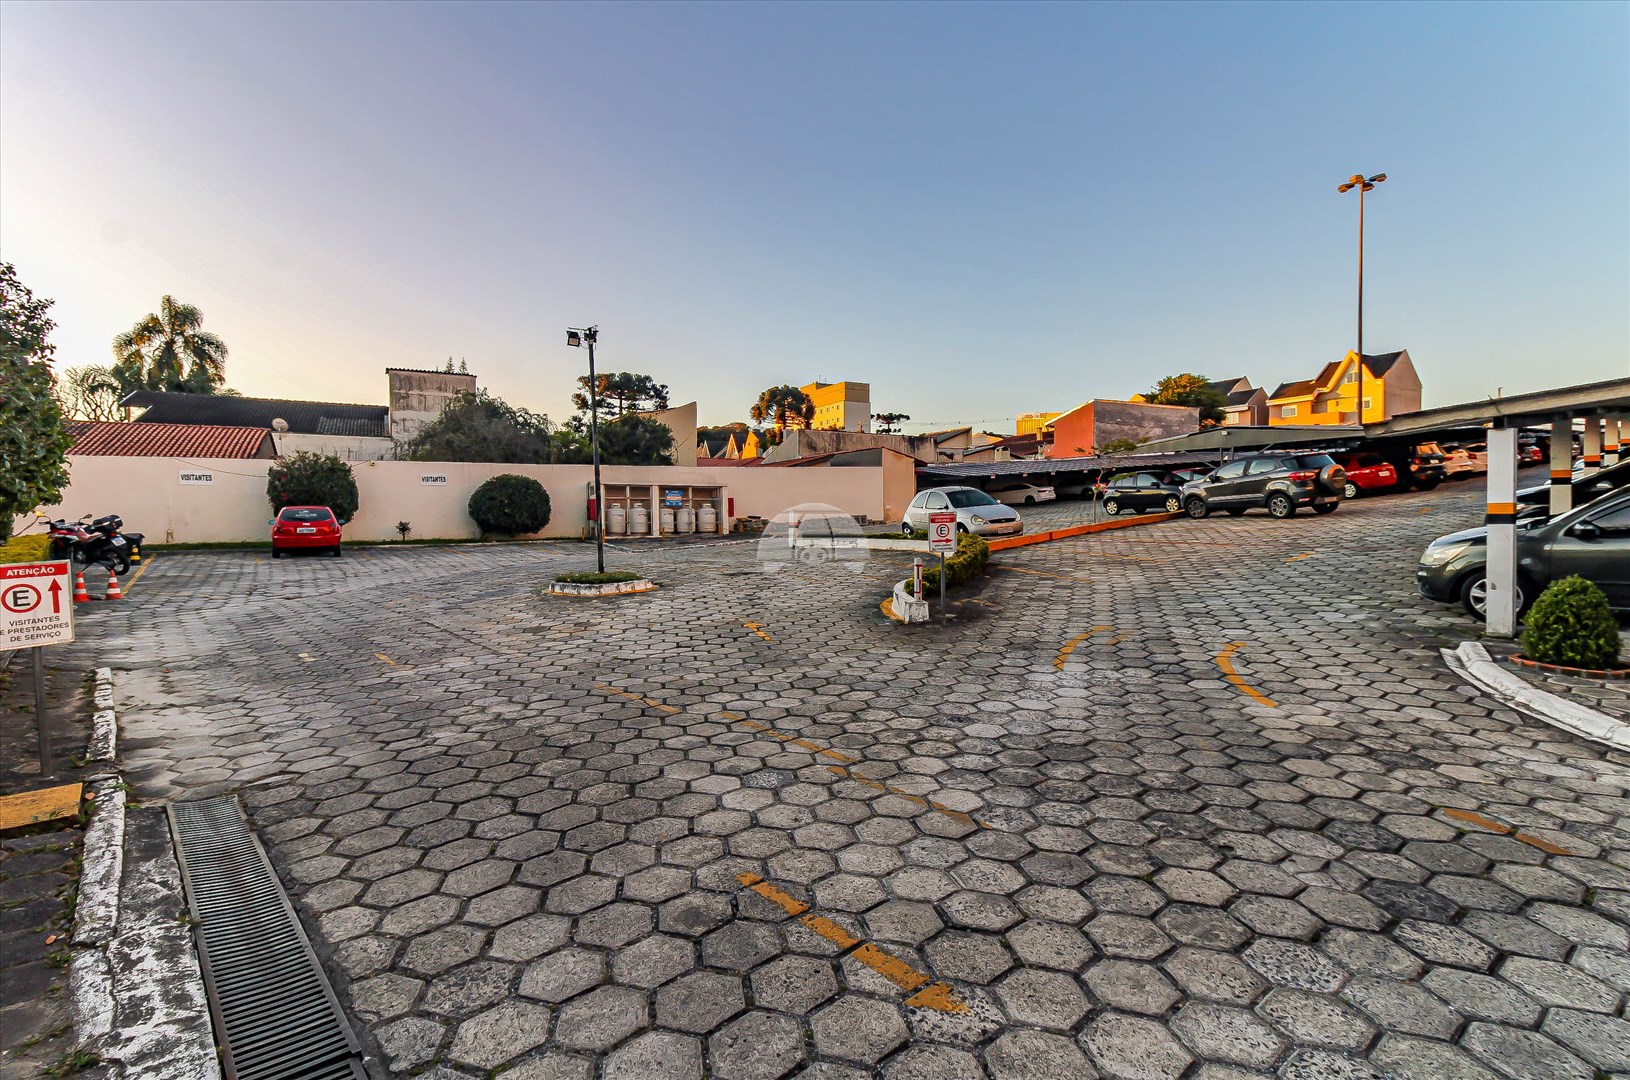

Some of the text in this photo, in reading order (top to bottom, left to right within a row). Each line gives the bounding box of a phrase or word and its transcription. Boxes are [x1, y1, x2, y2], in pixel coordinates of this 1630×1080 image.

[940, 526, 946, 535] E
[6, 566, 55, 576] ATENÇÃO
[12, 590, 31, 607] E
[9, 615, 60, 627] VISITANTES
[7, 622, 70, 635] PRESTADORES
[24, 630, 61, 641] SERVIÇO
